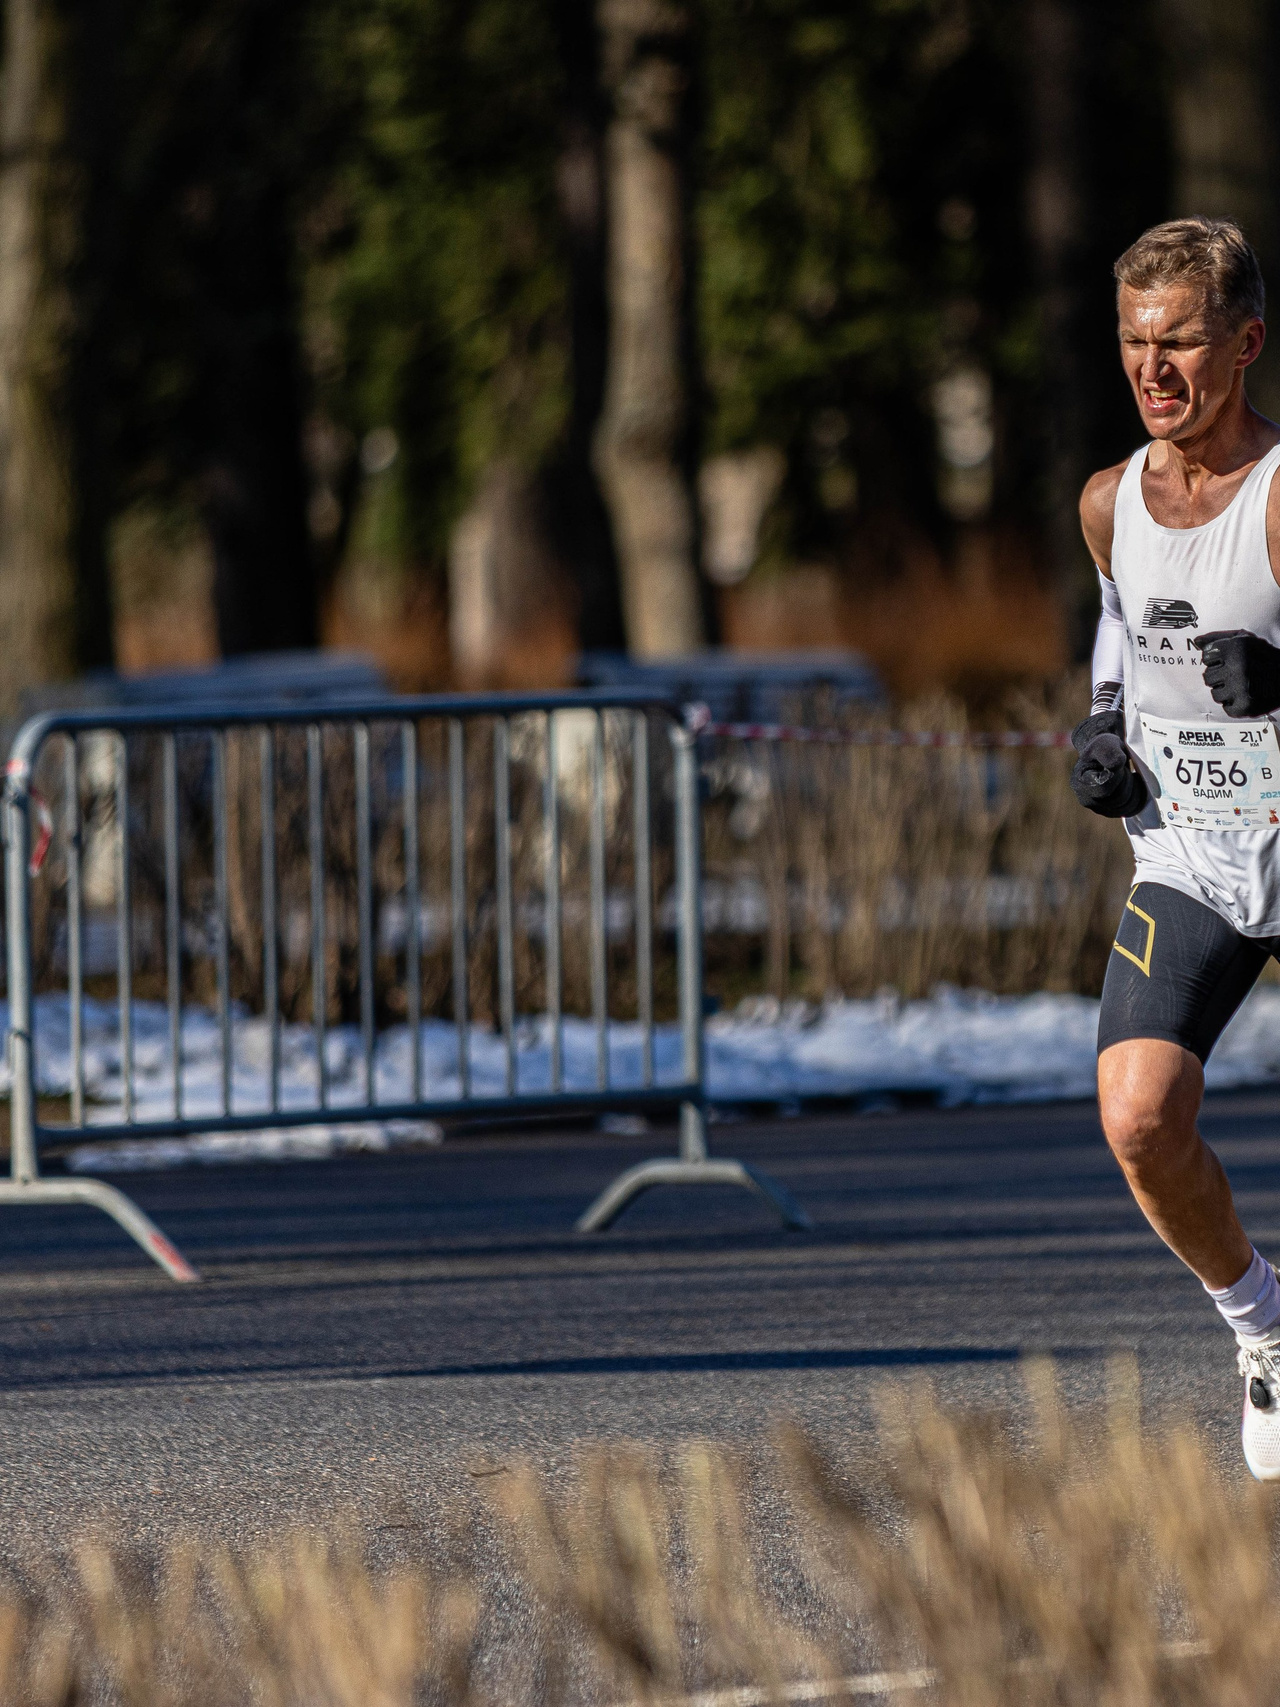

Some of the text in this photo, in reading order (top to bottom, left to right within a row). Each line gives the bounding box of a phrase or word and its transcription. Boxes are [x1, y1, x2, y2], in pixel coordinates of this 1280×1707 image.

[1138, 653, 1184, 665] БЕГОВОЙ
[1178, 731, 1224, 742] АРЕНА
[1175, 758, 1248, 787] 6756
[1192, 787, 1233, 800] ВАДИМ
